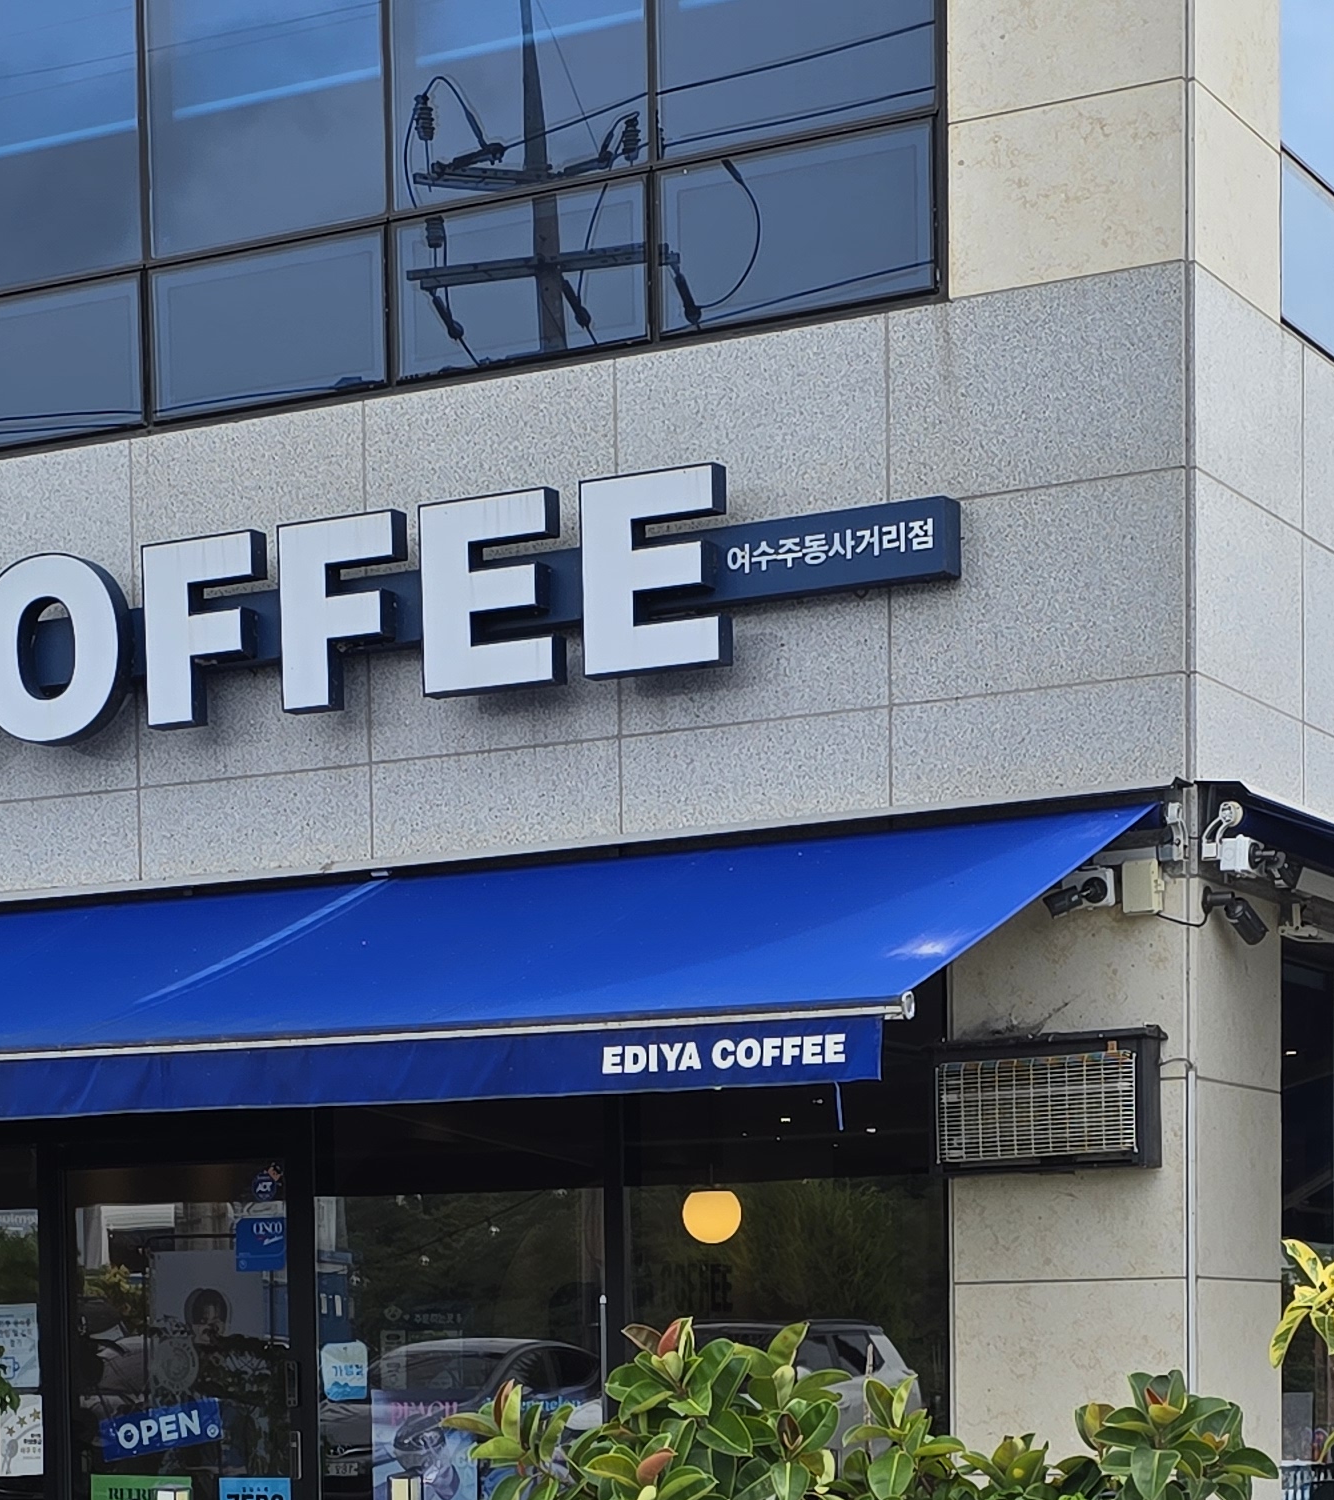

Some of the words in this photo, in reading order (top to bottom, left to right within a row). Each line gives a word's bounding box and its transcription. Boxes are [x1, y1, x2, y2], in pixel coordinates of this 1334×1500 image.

[727, 517, 934, 574] 여수주동사거리점
[601, 1042, 702, 1074] EDIYA
[711, 1034, 846, 1070] COFFEE
[116, 1410, 201, 1449] OPEN
